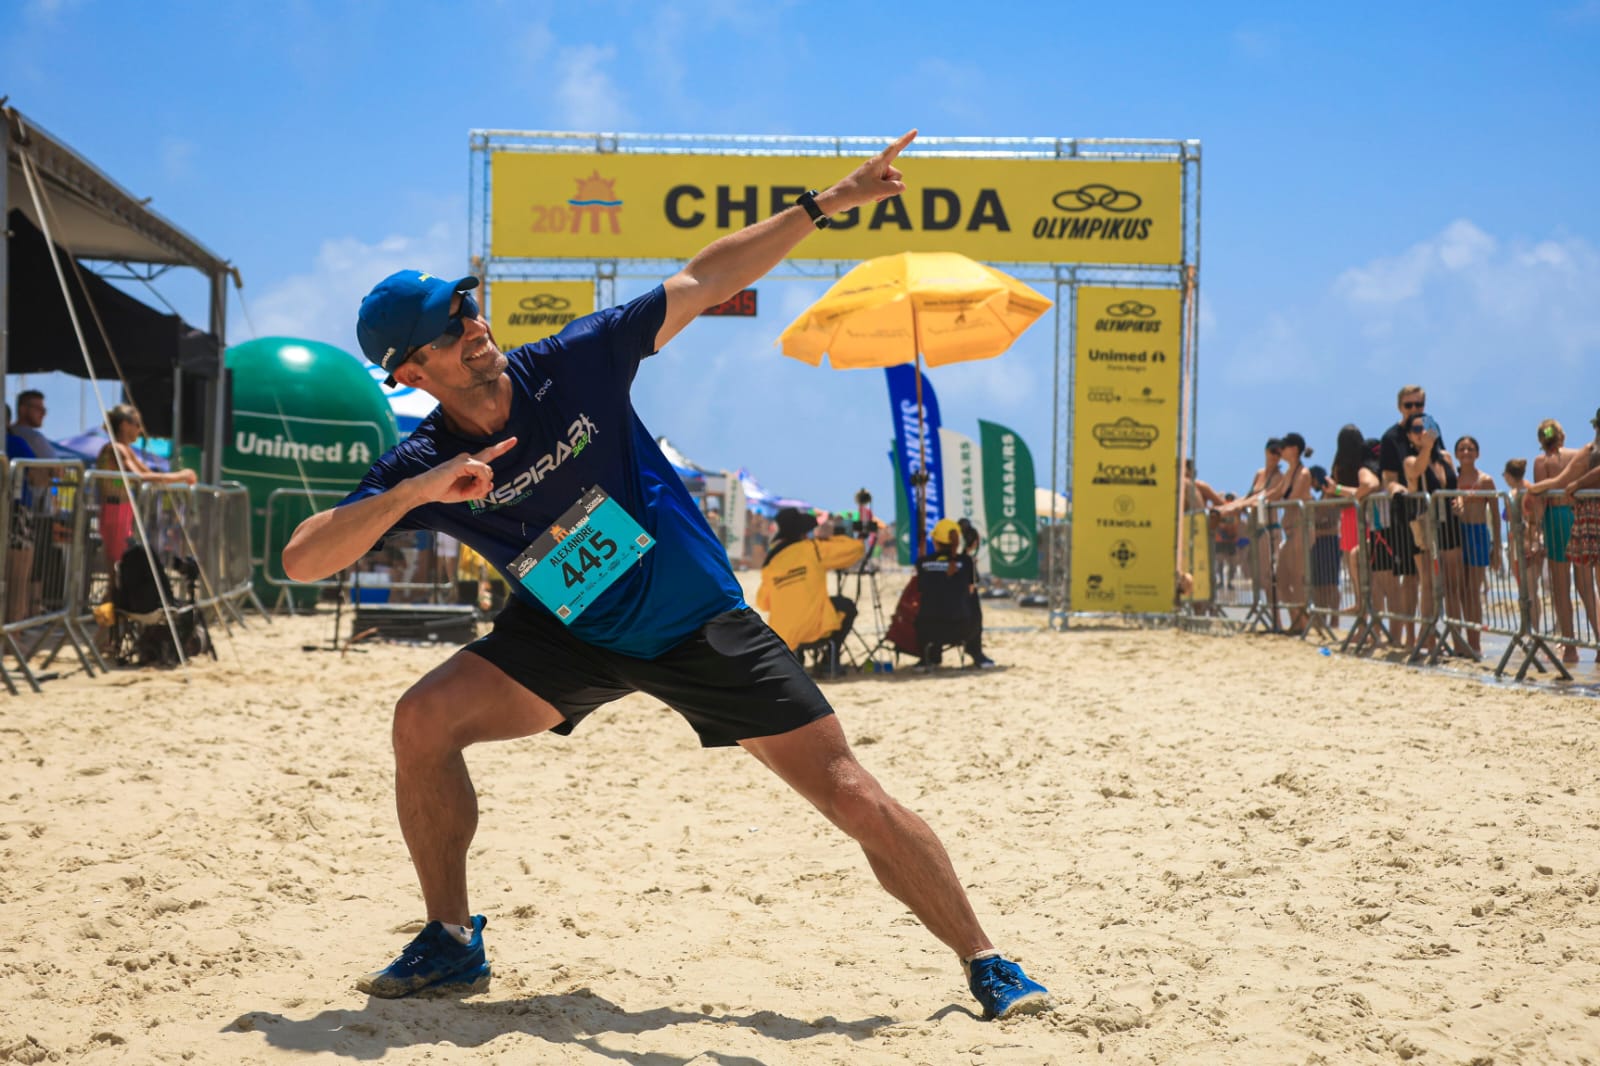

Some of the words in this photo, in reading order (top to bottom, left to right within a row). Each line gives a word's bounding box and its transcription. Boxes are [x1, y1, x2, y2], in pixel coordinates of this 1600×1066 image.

[1032, 217, 1153, 240] OLYMPIKUS
[1095, 319, 1162, 333] OLYMPIKUS
[1089, 350, 1147, 362] Unimed
[235, 431, 342, 463] Unimed
[1002, 434, 1016, 518] CEASA/RS
[1096, 519, 1151, 528] TERMOLAR
[550, 524, 595, 568] ALEXANDRE
[561, 531, 618, 589] 445
